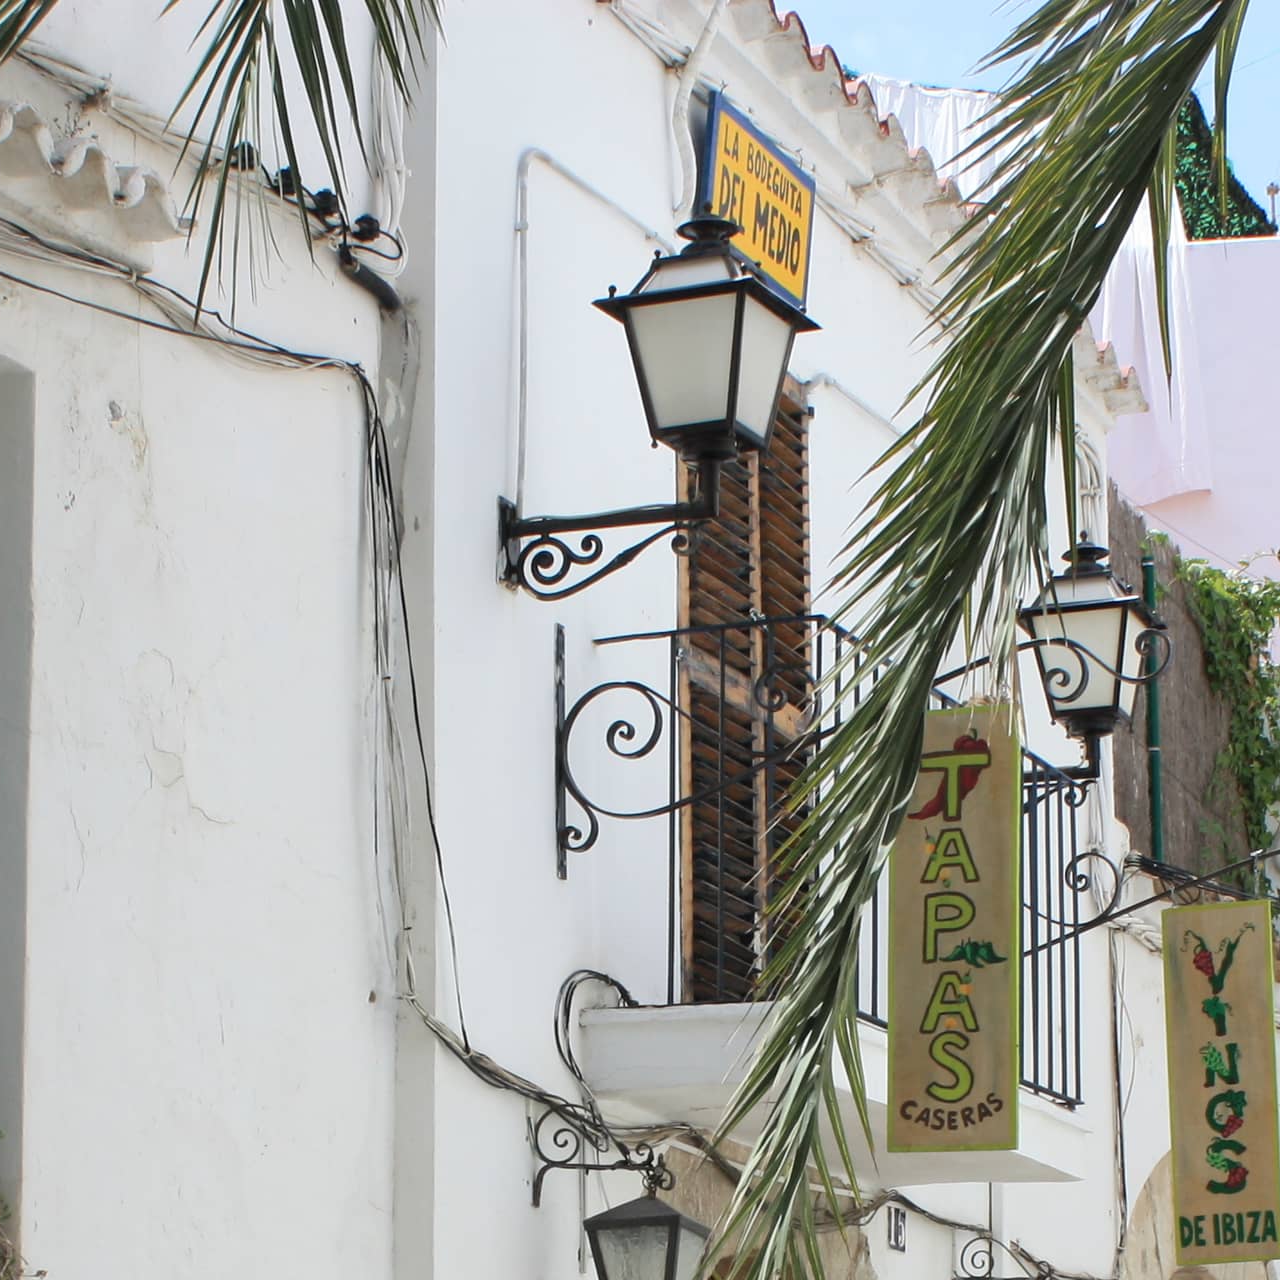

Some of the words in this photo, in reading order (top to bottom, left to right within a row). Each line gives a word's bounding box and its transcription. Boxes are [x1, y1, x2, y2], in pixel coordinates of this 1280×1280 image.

[719, 163, 745, 235] DEL
[753, 191, 802, 275] MEDIO
[723, 122, 739, 162] LA
[747, 142, 802, 219] BODEGUITA
[919, 750, 991, 1104] TAPAS
[899, 1092, 1004, 1131] CASERAS
[1191, 926, 1250, 1195] VINOS
[1179, 1215, 1206, 1249] DE
[1212, 1209, 1278, 1246] IBIZA
